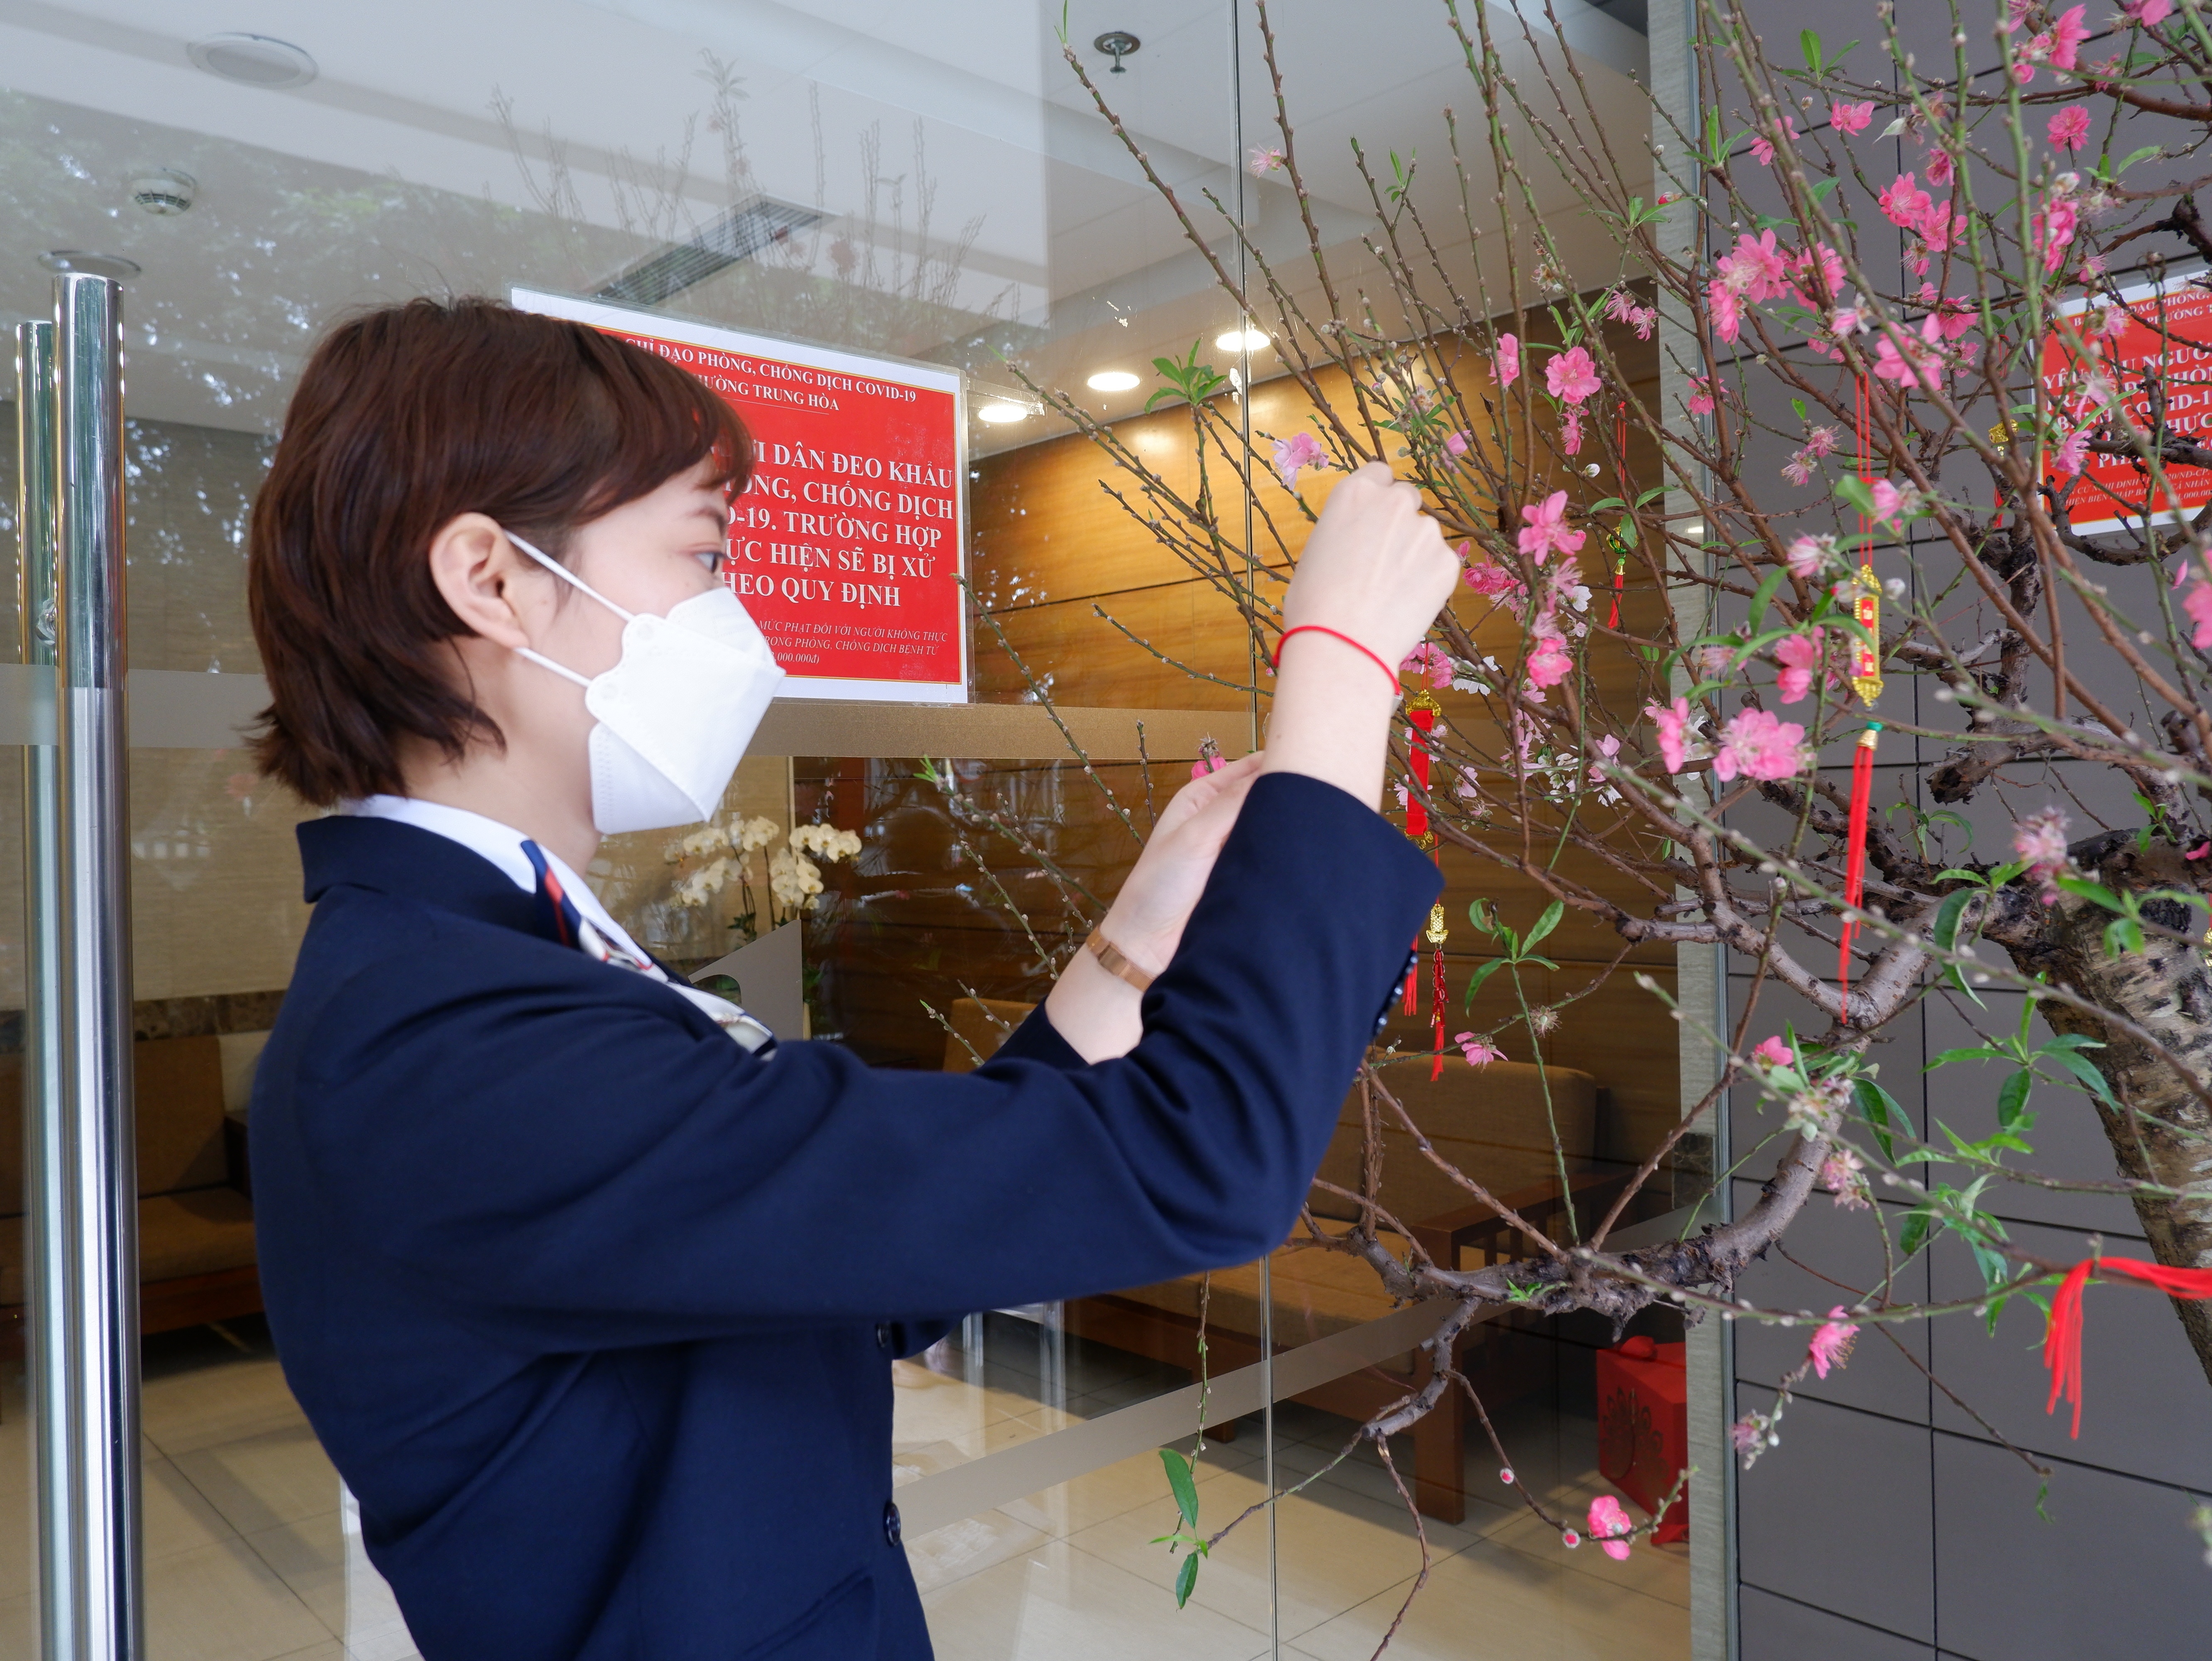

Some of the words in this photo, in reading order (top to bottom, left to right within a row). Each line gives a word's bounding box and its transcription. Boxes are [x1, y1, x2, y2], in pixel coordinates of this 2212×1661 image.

[659, 345, 694, 363] ĐẠO
[698, 353, 756, 376] PHÒNG,
[760, 364, 813, 384] CHỐNG
[817, 374, 852, 391] DỊCH
[856, 381, 916, 402] COVID-19
[697, 375, 748, 395] ƯỜNG
[753, 385, 804, 404] TRUNG
[808, 393, 839, 410] HÒA
[773, 441, 825, 471] DÂN
[832, 453, 882, 478] ĐEO
[888, 461, 952, 489] KHẨU
[803, 480, 891, 511] CHỐNG
[897, 493, 954, 520] DỊCH
[783, 511, 888, 542] TRƯỜNG
[895, 524, 942, 552] HỢP
[727, 536, 762, 566] ỰC
[769, 543, 831, 572] HIỆN
[838, 546, 866, 572] SẼ
[872, 553, 896, 580] BỊ
[901, 553, 936, 578] XỬ
[722, 572, 774, 596] HEO
[781, 577, 834, 603] QUY
[841, 582, 901, 609] ĐỊNH
[759, 618, 783, 631] MỨC
[785, 622, 811, 634] PHẠT
[813, 622, 832, 634] ĐỐI
[834, 623, 851, 635] VỚI
[853, 625, 885, 638] NGƯỜI
[887, 628, 920, 640] KHÔNG
[923, 631, 948, 642] THỰC
[764, 636, 792, 647] RONG
[795, 636, 832, 650] PHÒNG,
[836, 639, 871, 652] CHỐNG
[873, 642, 897, 653] DỊCH
[899, 644, 923, 655] BỆNH
[926, 644, 939, 655] TỪ
